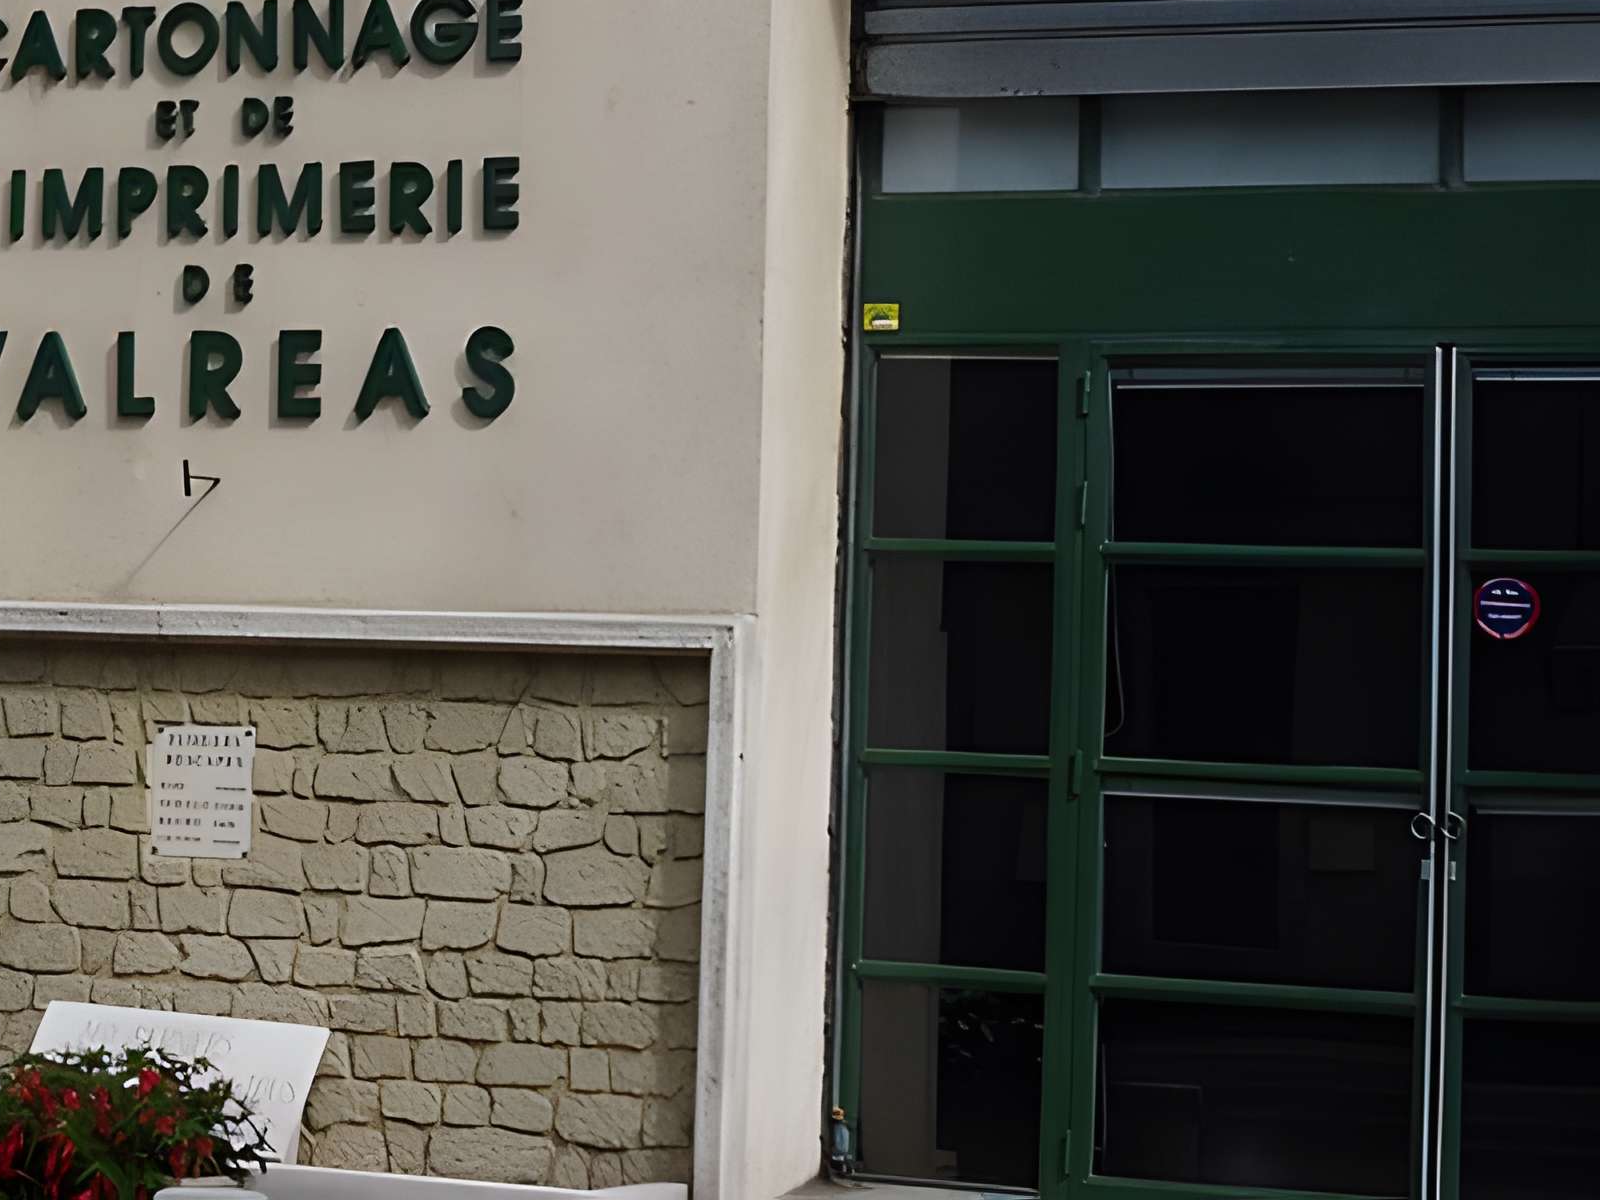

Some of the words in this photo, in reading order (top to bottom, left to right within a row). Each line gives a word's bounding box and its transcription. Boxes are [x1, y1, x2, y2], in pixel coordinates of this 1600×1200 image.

[155, 100, 199, 140] ET
[242, 96, 294, 138] DE
[182, 263, 254, 304] DE
